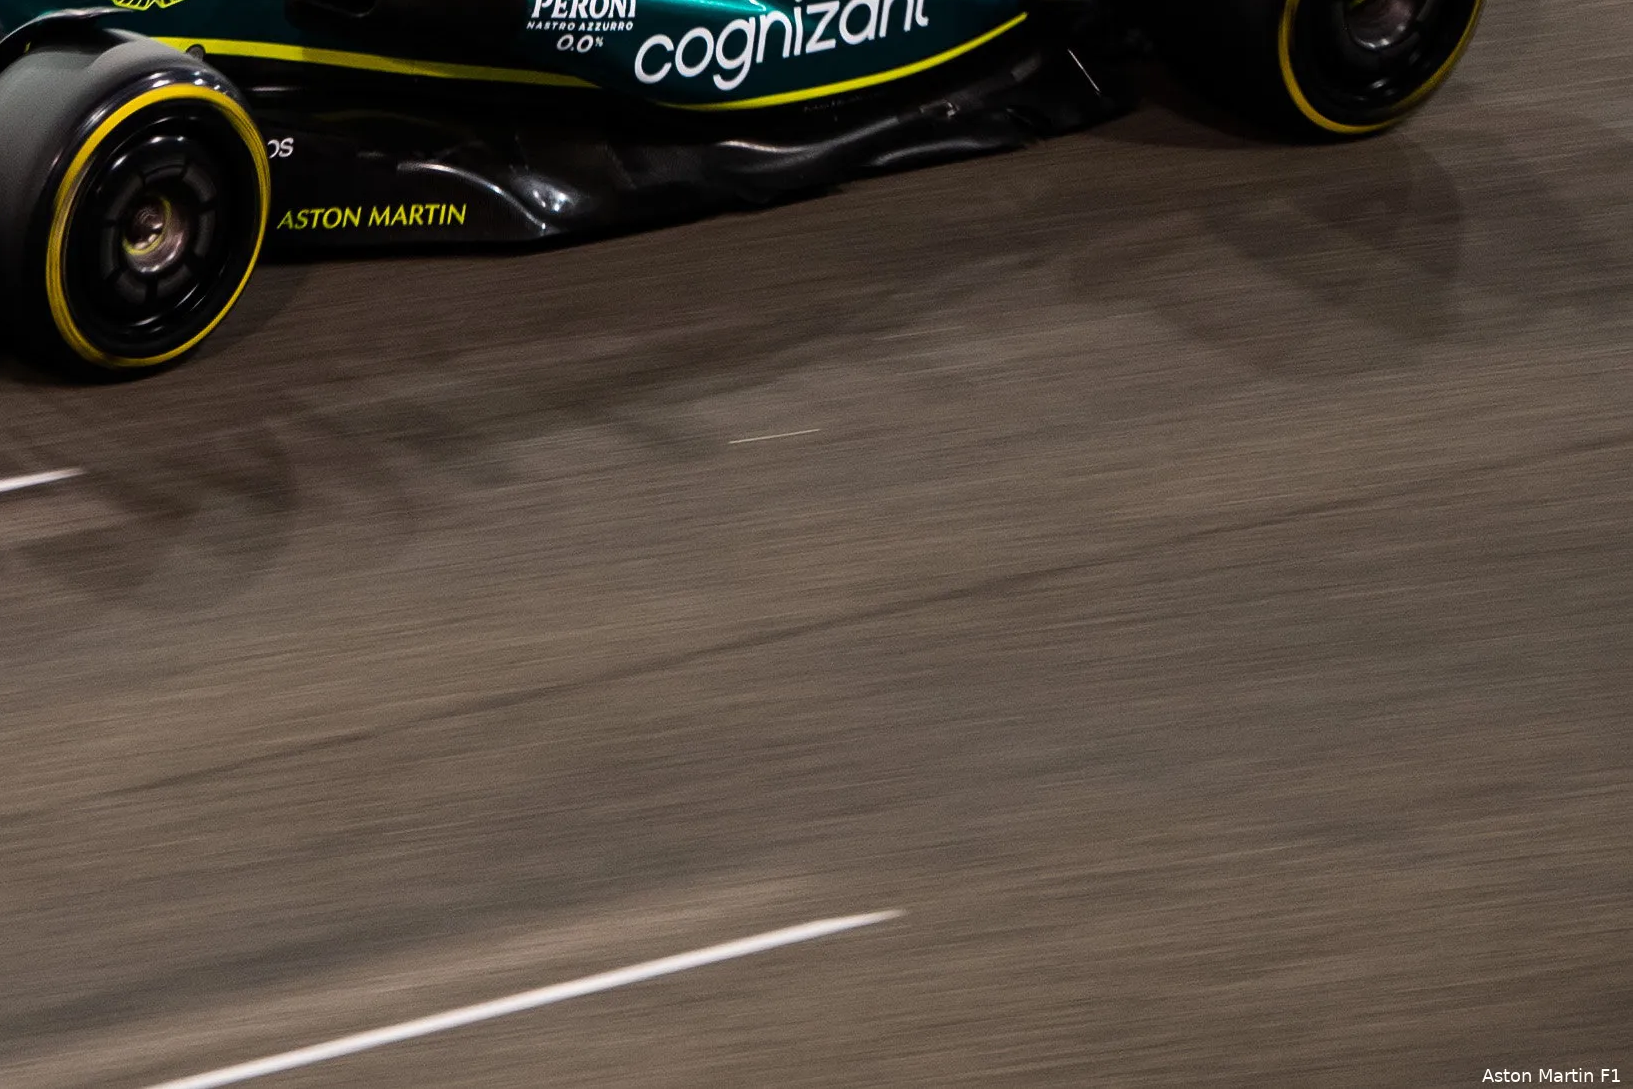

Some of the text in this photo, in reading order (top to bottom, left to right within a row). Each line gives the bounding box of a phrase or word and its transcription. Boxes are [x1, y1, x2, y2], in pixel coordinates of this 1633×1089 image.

[526, 20, 634, 32] NASTRO AZZURRO
[277, 203, 467, 230] ASTON MARTIN
